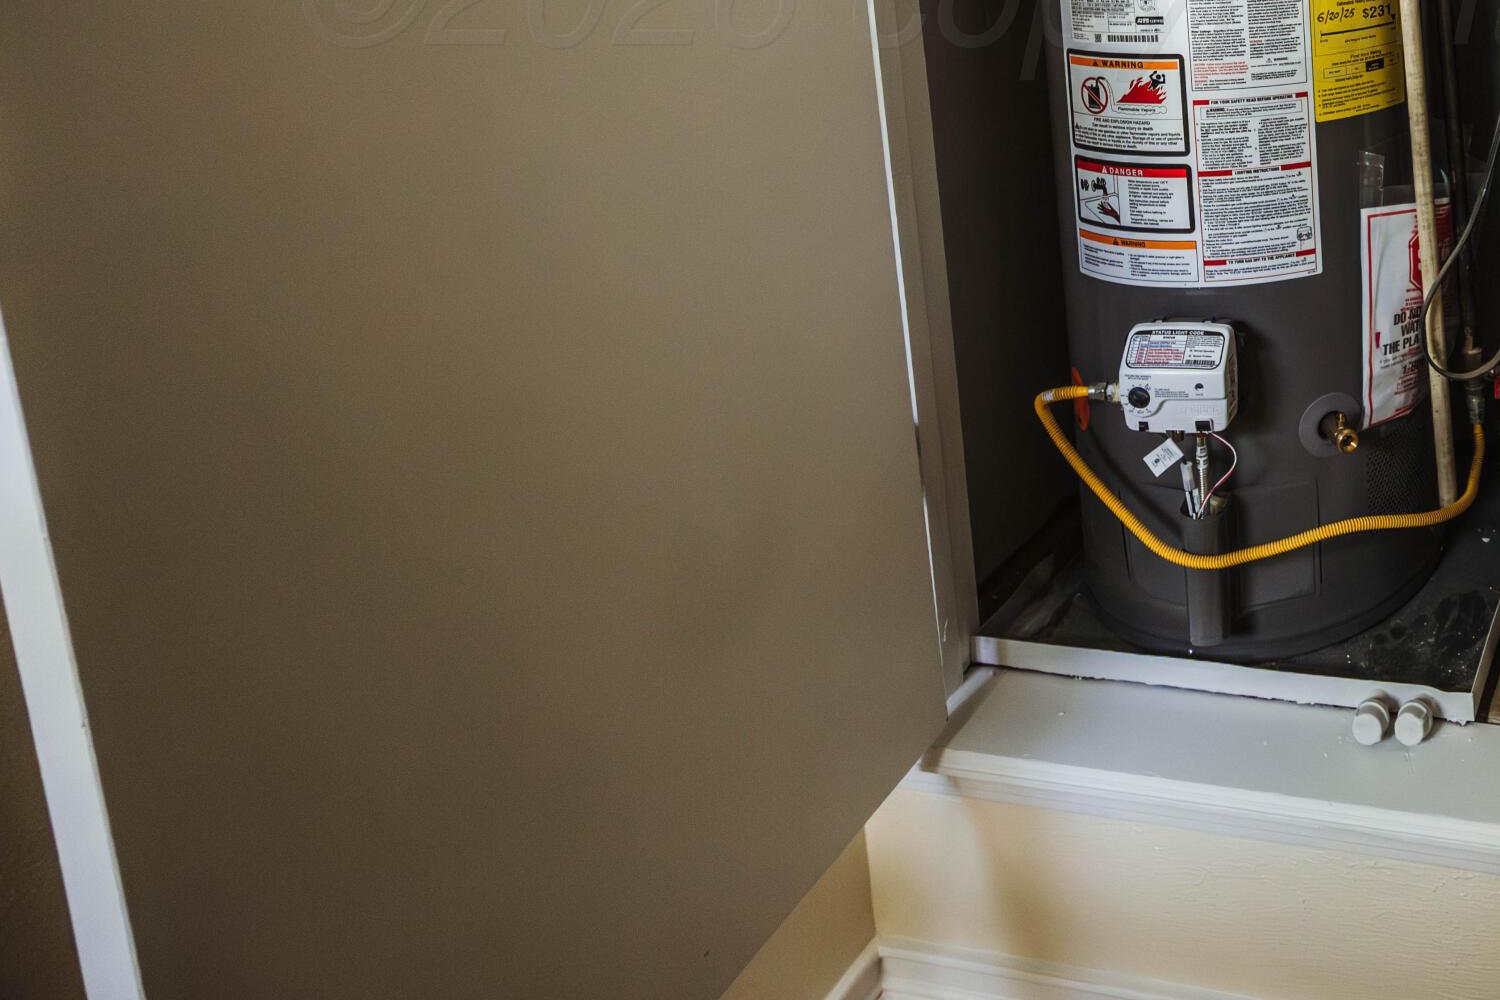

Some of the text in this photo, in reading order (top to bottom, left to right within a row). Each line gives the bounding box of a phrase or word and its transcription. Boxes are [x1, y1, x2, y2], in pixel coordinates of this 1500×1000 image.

[1362, 3, 1391, 19] $231
[1102, 60, 1144, 69] WARNING
[1110, 167, 1143, 176] DANGER
[1394, 312, 1406, 326] DO
[1401, 322, 1420, 337] WAT
[1383, 333, 1420, 356] THE PLA
